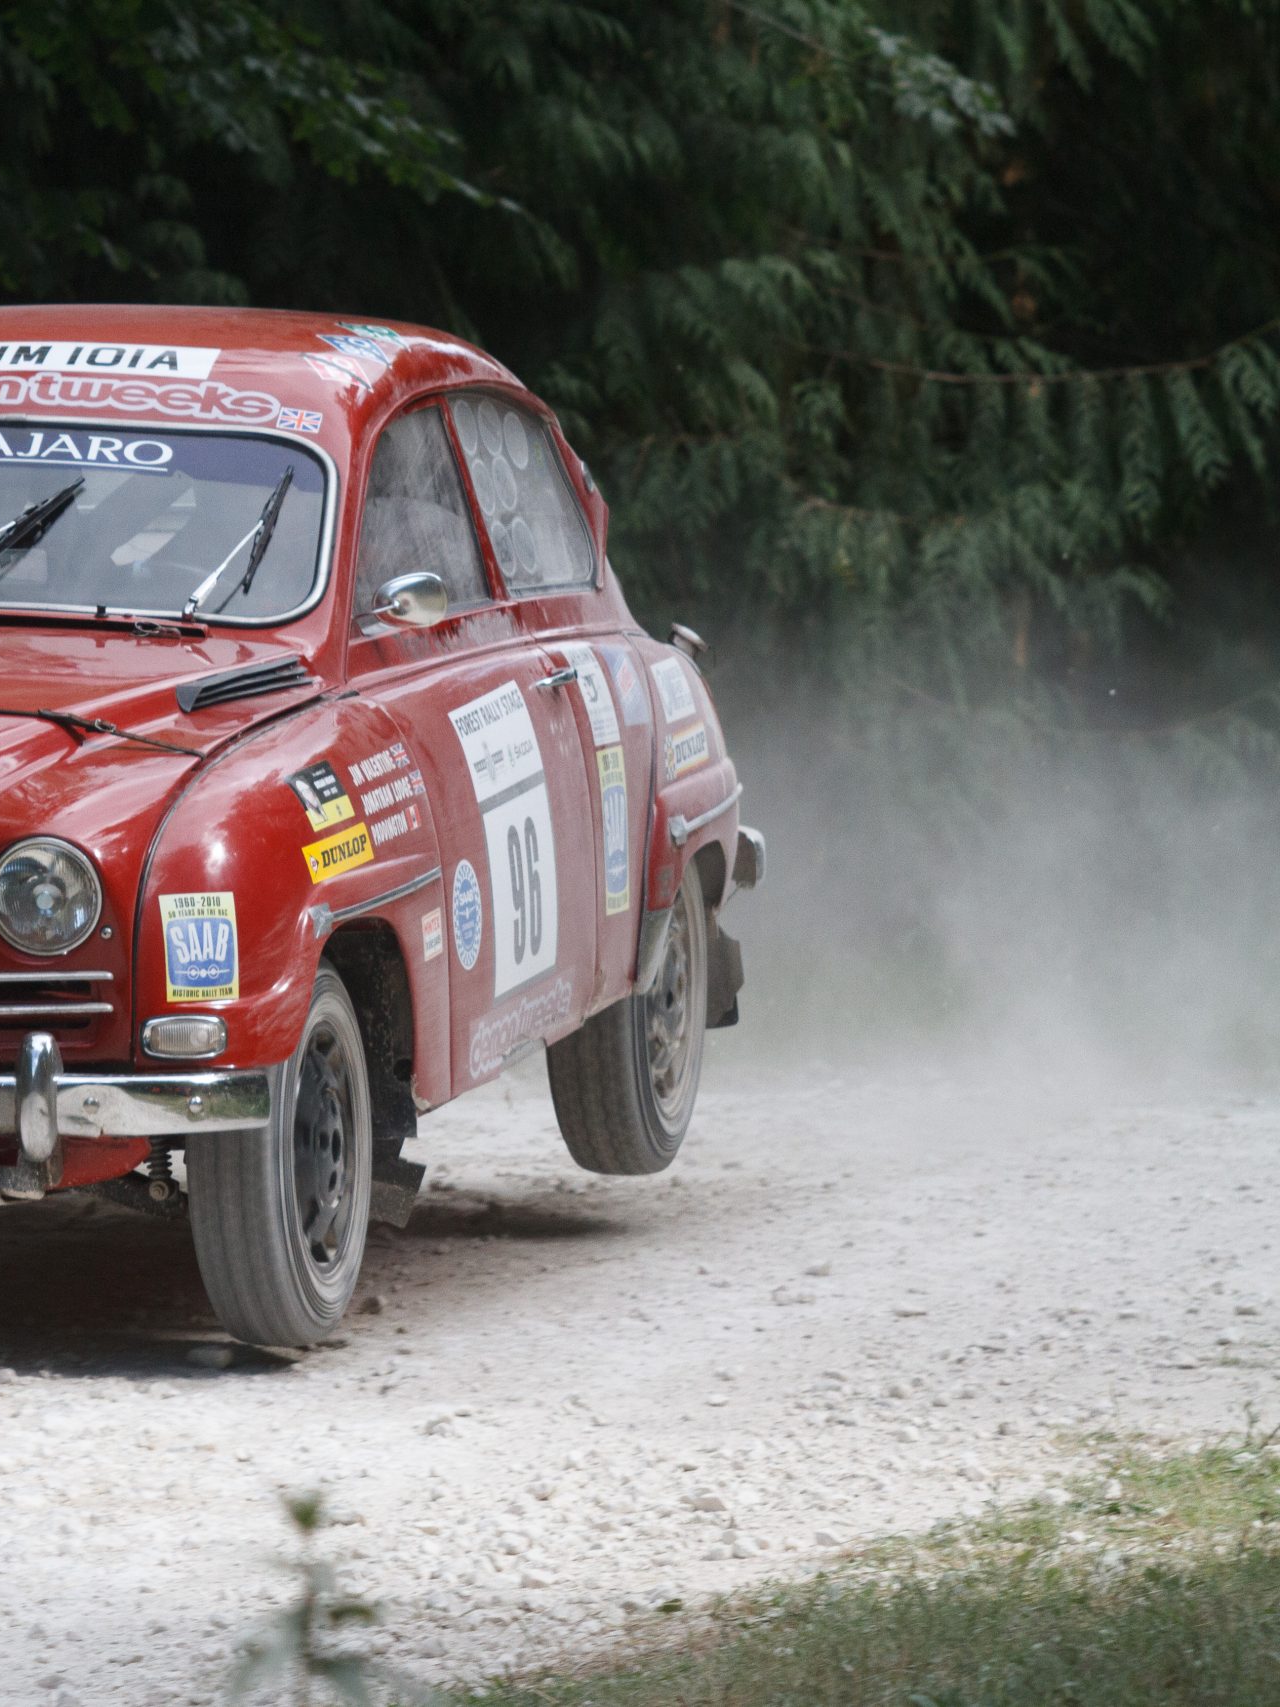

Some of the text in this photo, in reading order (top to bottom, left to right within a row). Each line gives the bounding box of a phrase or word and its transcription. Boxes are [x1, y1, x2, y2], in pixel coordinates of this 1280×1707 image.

[66, 346, 179, 371] 101A
[454, 688, 524, 739] FOREST RALLY STAGE
[674, 731, 705, 764] DUNLOP
[320, 833, 367, 868] DUNLOP
[506, 815, 542, 966] 96
[169, 921, 230, 965] SAAB
